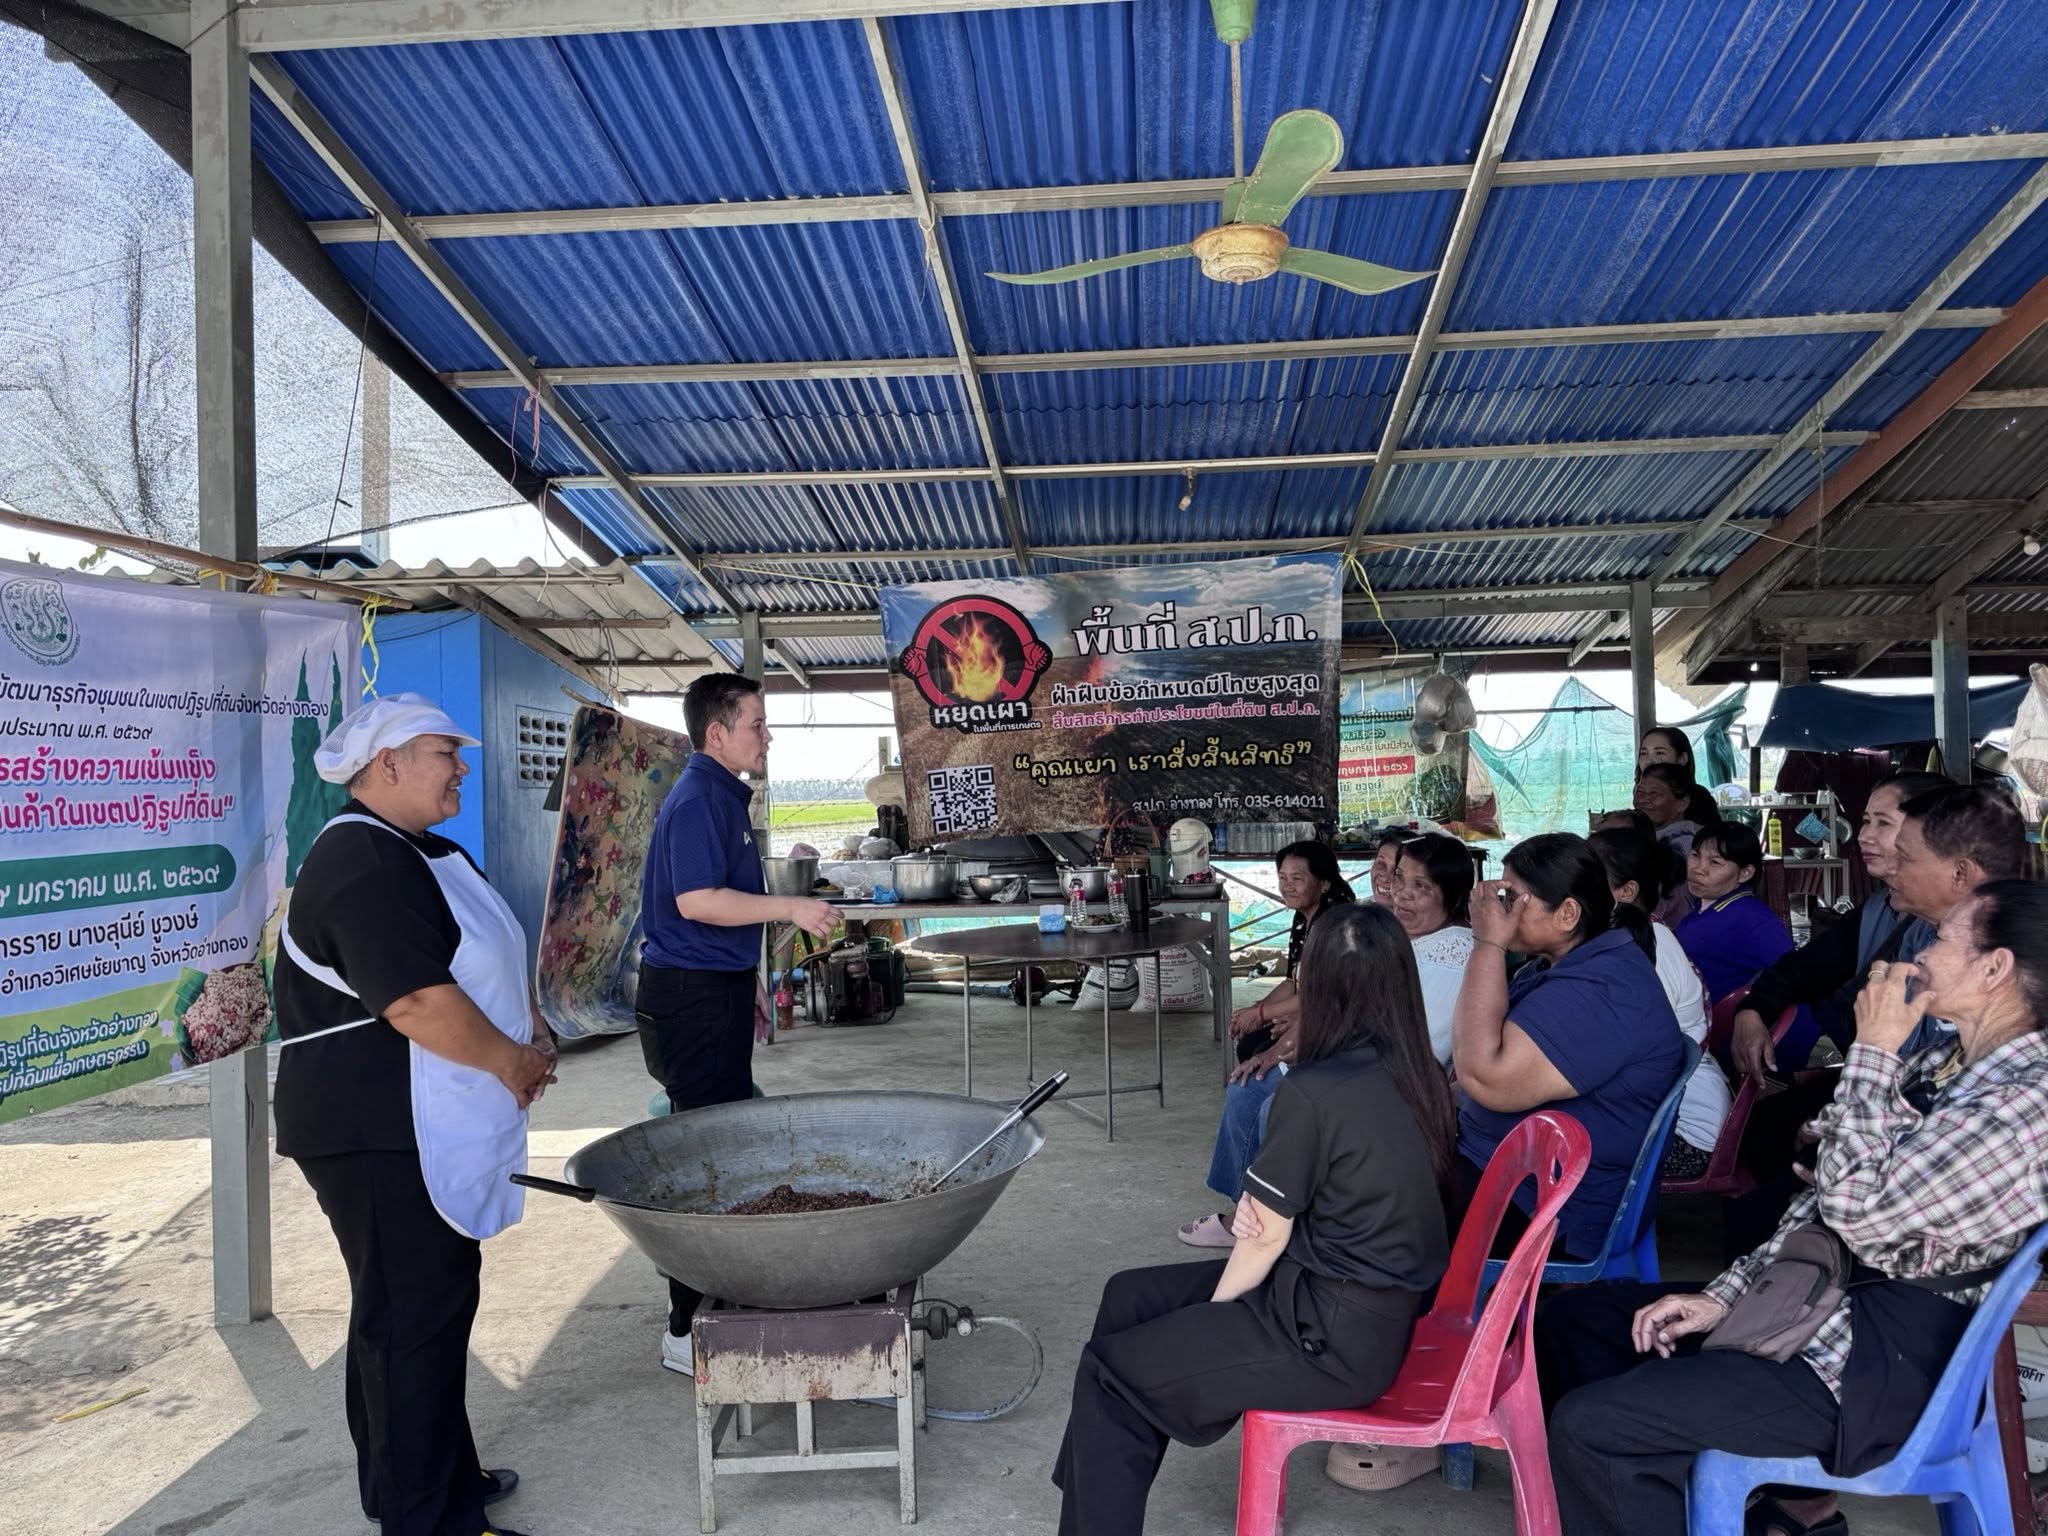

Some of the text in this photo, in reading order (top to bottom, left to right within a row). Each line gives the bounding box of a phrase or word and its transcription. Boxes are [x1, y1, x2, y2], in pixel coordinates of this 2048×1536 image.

[1073, 601, 1318, 655] พื้นที่ ส.ป.ก.
[1051, 673, 1319, 705] ฝ่าฝืนข้อกำหนดมีโทษสูงสุด
[934, 702, 1028, 727] หยุดเผา
[1271, 701, 1320, 716] ส.ป.ก.
[78, 723, 108, 738] พ.ศ.
[113, 725, 153, 739] ๒๕๖๙
[973, 720, 1041, 733] ในพื้นที่การเกษตร
[0, 783, 234, 831] นค้าในเขตปฏิรูปที่ดิน"
[1170, 795, 1212, 810] อ่างทอง
[1245, 795, 1325, 808] 035-614011
[18, 876, 106, 905] มกราคม
[114, 870, 157, 893] พ.ศ.
[163, 864, 220, 888] ๒๕๖๙
[69, 911, 145, 951] นางสุนีย์
[152, 904, 200, 944] ชูวงษ์
[2, 935, 248, 994] อำเภอวิเศษชัยชาญ จังหวัดอ่างทอง
